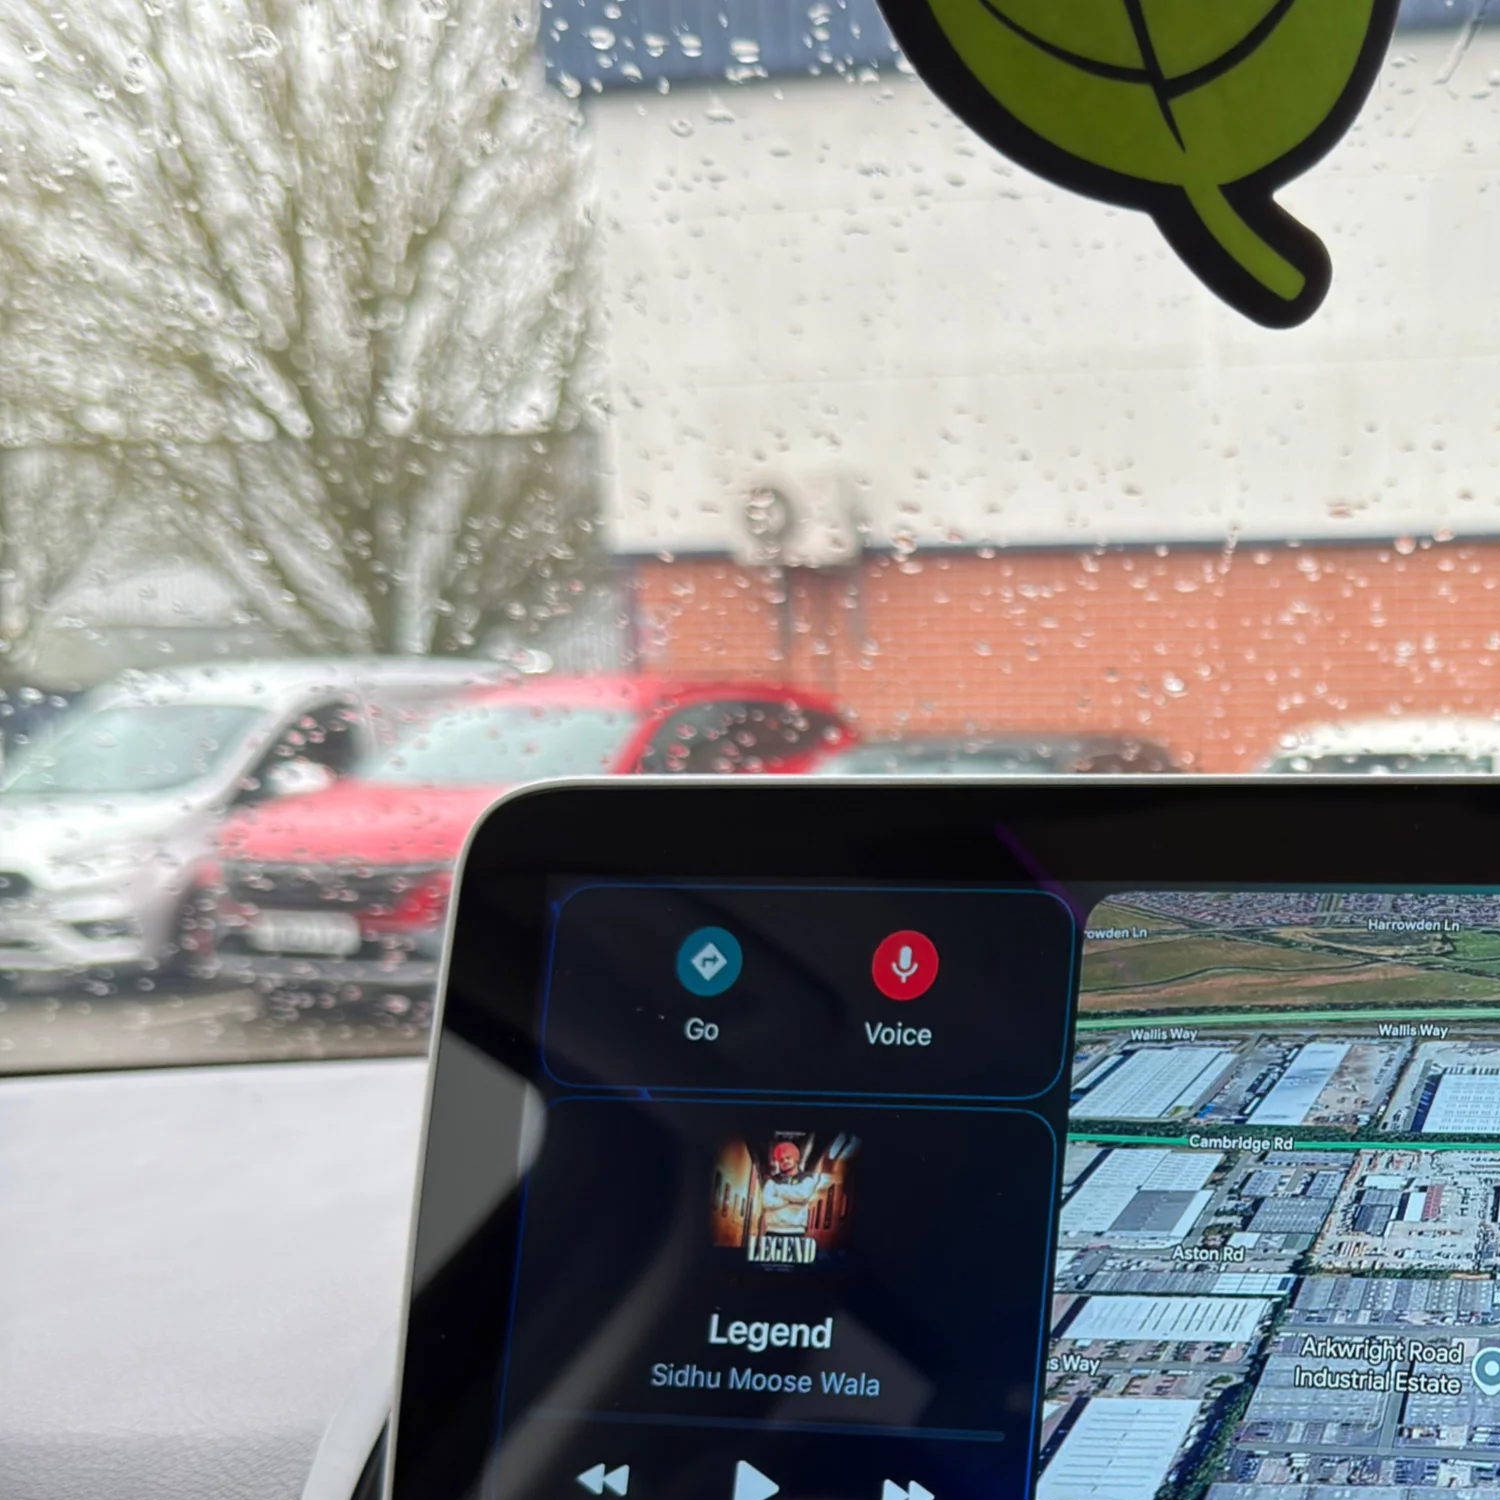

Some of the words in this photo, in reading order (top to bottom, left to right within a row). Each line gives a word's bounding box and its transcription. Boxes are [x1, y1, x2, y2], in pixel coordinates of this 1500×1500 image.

[1132, 926, 1148, 938] Ln
[1368, 918, 1441, 931] Harrowden
[1444, 919, 1460, 932] Ln
[684, 1017, 719, 1041] Go
[865, 1021, 932, 1046] Voice
[1130, 1028, 1168, 1041] Wallis
[1170, 1028, 1198, 1043] Way
[1378, 1024, 1416, 1037] Wallis
[1417, 1025, 1449, 1040] Way
[1189, 1135, 1271, 1153] Cambridge
[1273, 1136, 1294, 1151] Rd
[747, 1235, 817, 1263] LEGEND
[1172, 1247, 1220, 1262] Aston
[1223, 1247, 1244, 1262] Rd
[708, 1313, 833, 1352] Legend
[1300, 1336, 1404, 1365] Arkwright
[1409, 1342, 1464, 1364] Road
[1062, 1354, 1100, 1376] Way
[651, 1363, 721, 1388] Sidhu
[729, 1367, 812, 1394] Moose
[820, 1371, 881, 1396] Wala
[1294, 1367, 1391, 1391] Industrial
[1395, 1372, 1462, 1395] Estate
